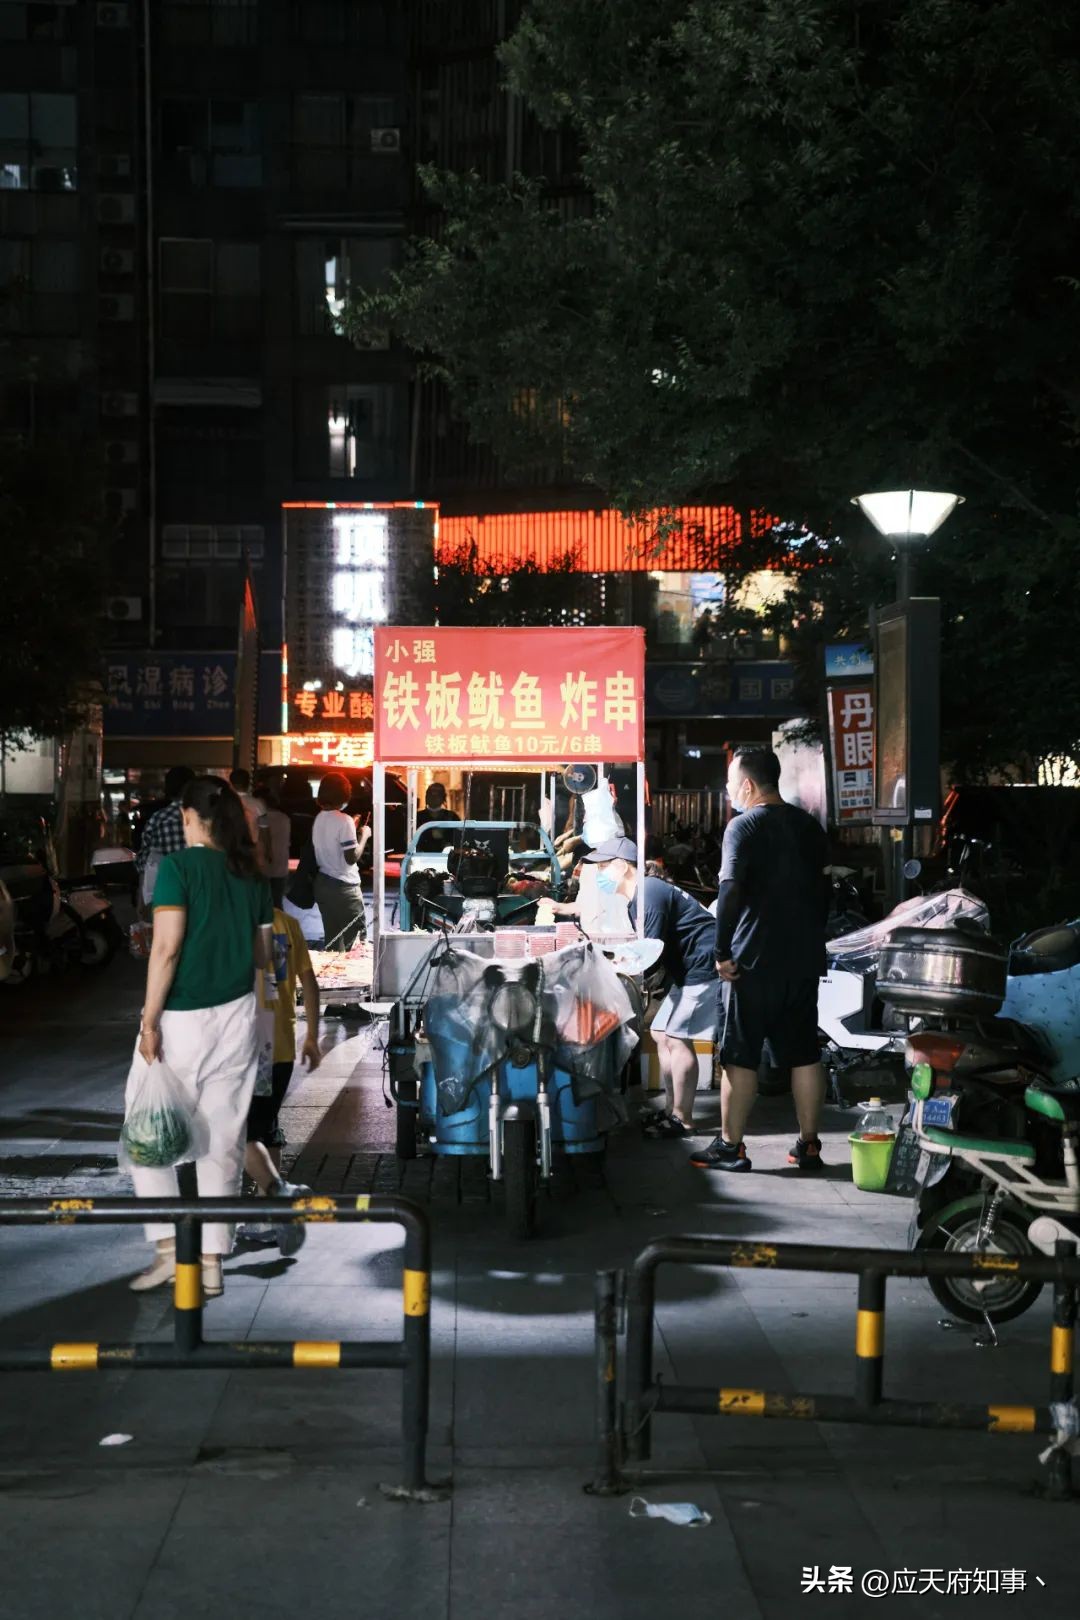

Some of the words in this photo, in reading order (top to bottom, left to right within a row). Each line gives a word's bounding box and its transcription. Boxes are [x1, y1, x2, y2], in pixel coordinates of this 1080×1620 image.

[385, 639, 437, 664] 小强
[294, 690, 374, 719] 专业酸
[382, 671, 546, 732] 铁板鱿鱼
[560, 670, 637, 732] 炸串
[425, 734, 602, 755] 铁板鱿鱼10元/6串
